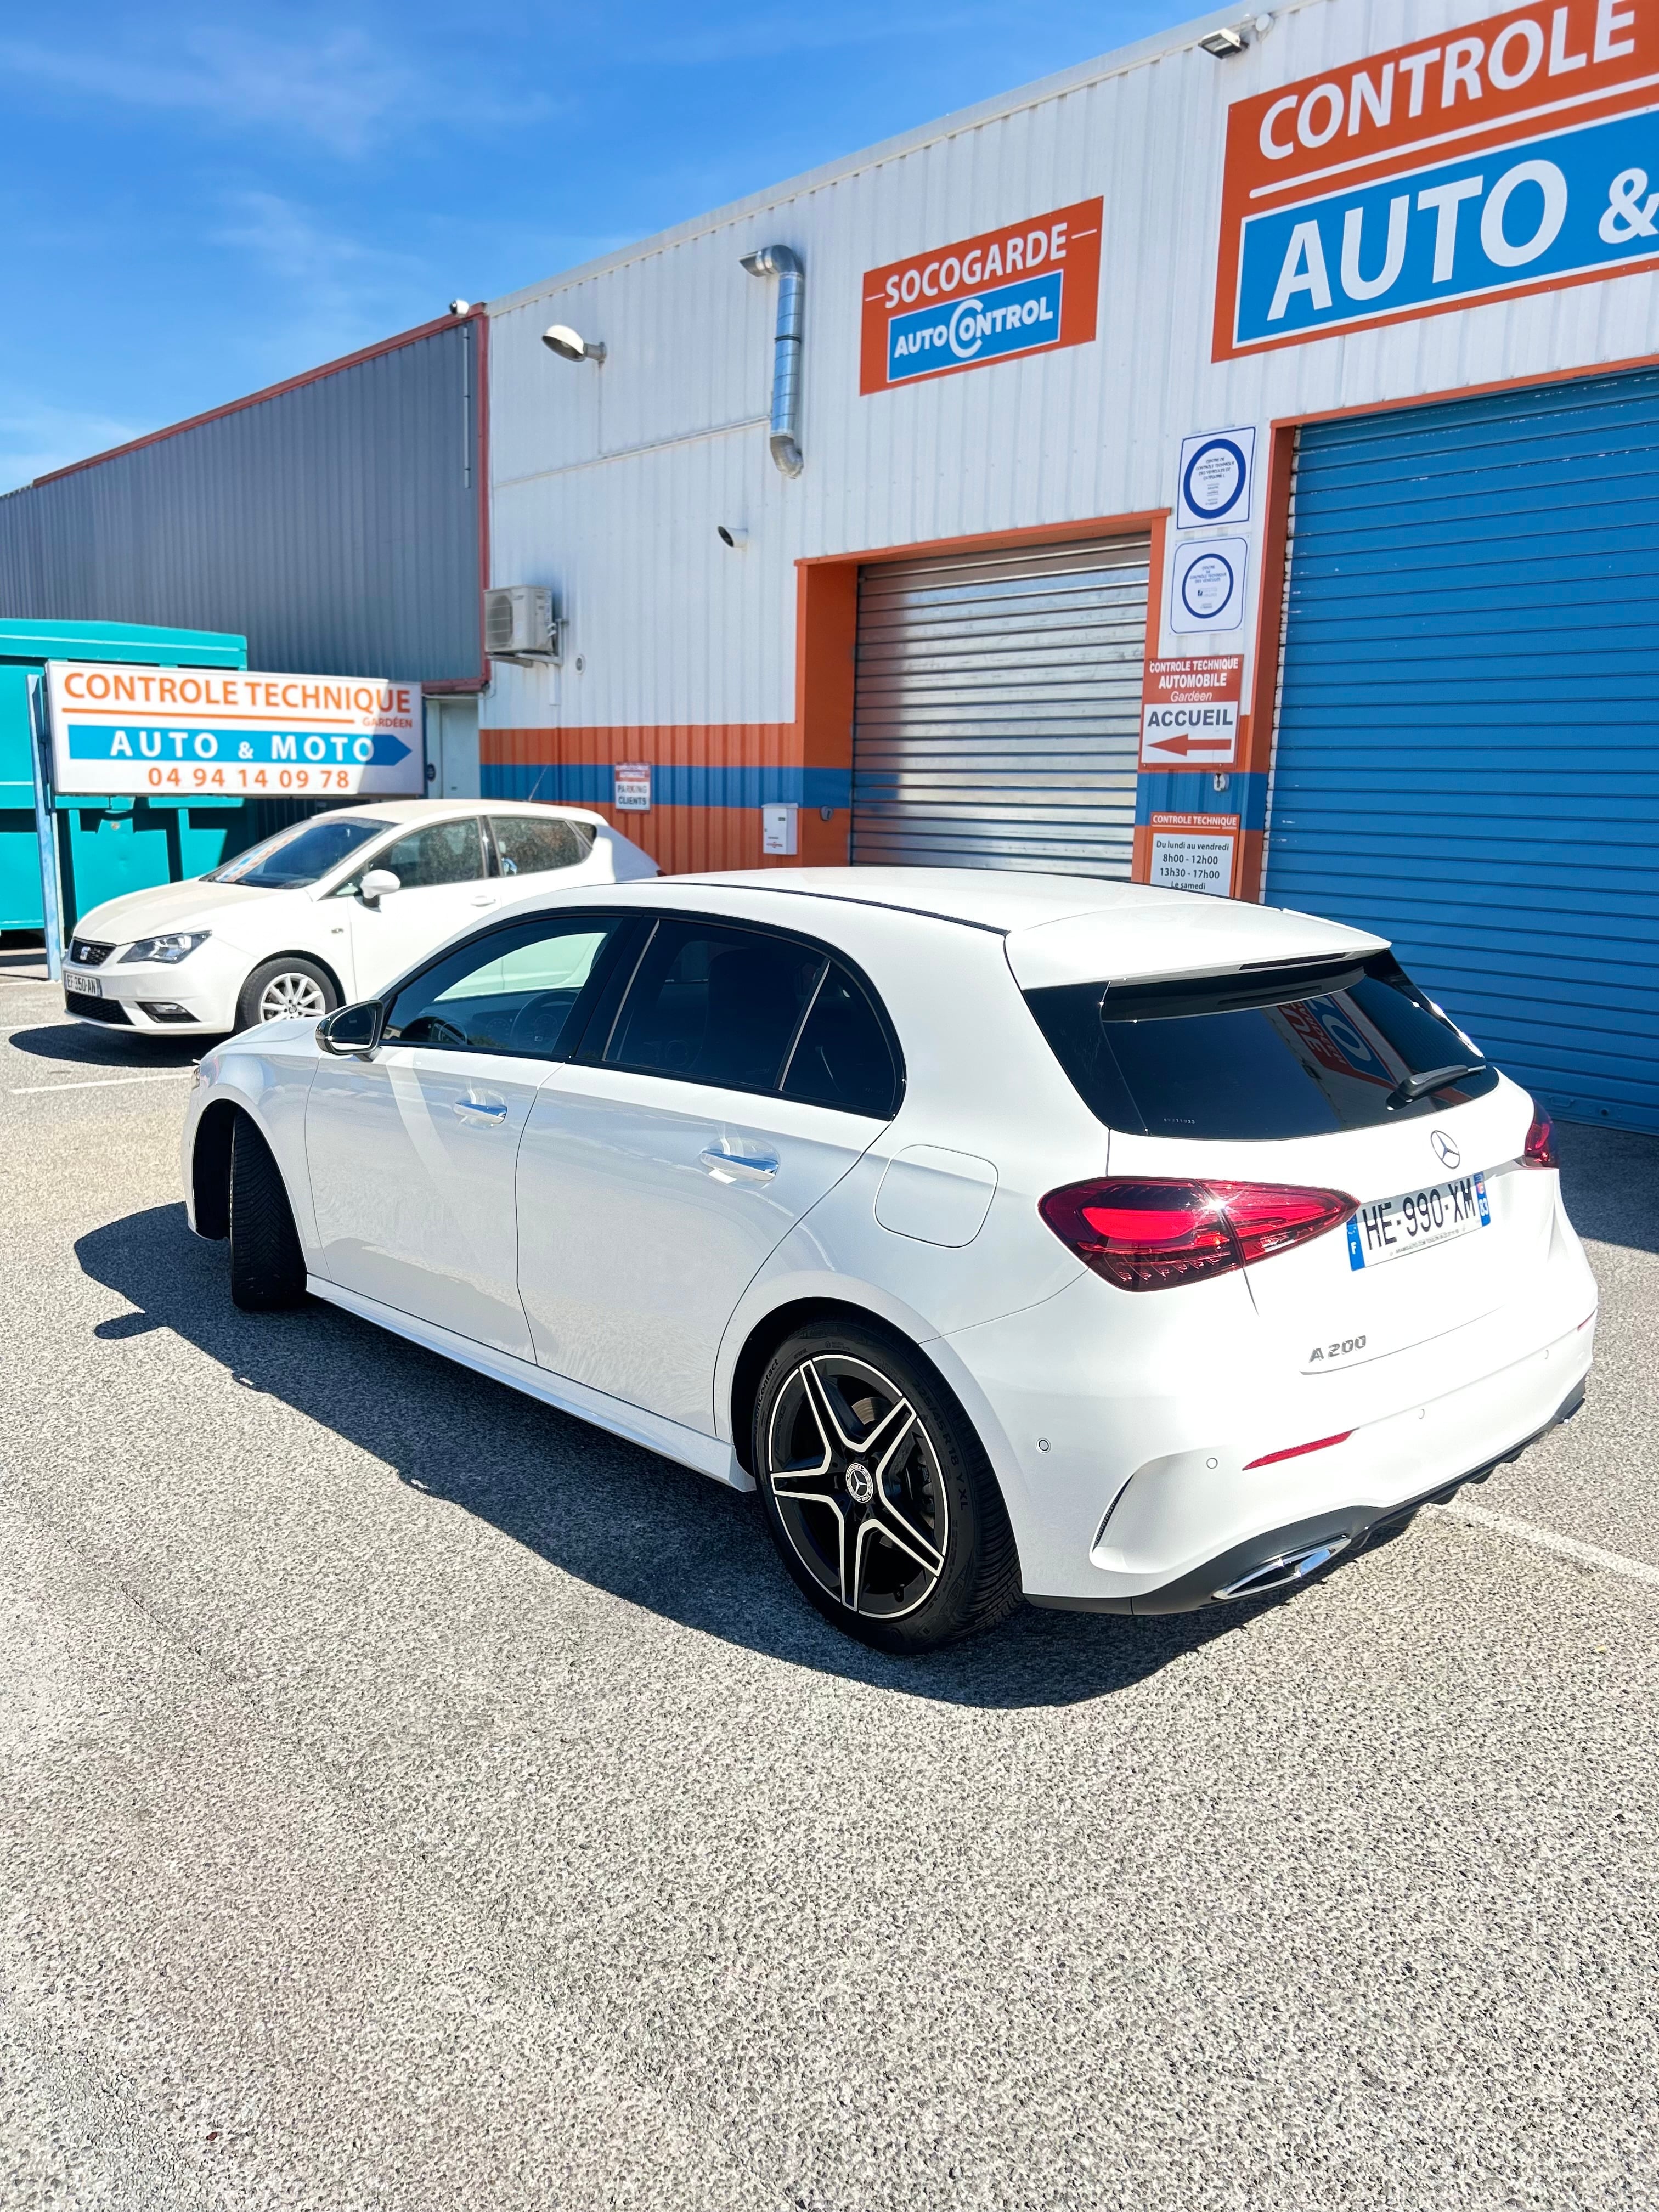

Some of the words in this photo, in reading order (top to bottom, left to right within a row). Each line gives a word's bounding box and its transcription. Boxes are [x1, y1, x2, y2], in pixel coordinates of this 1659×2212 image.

[1259, 0, 1635, 160] CONTROLE
[1267, 159, 1568, 321] AUTO
[1598, 167, 1659, 244] &
[884, 222, 1068, 309] SOCOGARDE
[1149, 660, 1191, 673] CONTROLE
[1193, 658, 1239, 671] TECHNIQUE
[1158, 673, 1227, 689] AUTOMOBILE
[64, 673, 238, 706] CONTROLE
[245, 682, 411, 715] TECHNIQUE
[362, 715, 413, 729] GARDÉEN
[1147, 709, 1233, 727] ACCUEIL
[110, 730, 218, 758] AUTO
[237, 741, 254, 759] &
[272, 735, 375, 761] MOTO
[148, 767, 182, 787] 04
[193, 768, 225, 787] 94
[238, 768, 268, 788] 14
[279, 769, 309, 788] 09
[320, 770, 350, 788] 78
[618, 796, 647, 805] CLIENTS
[1153, 815, 1192, 825] CONTROLE
[1193, 816, 1237, 827] TECHNIQUE
[1167, 840, 1186, 849] lundi
[1197, 842, 1229, 851] vendredi
[1163, 854, 1184, 863] 8h00
[1192, 855, 1218, 865] 12h00
[1160, 867, 1186, 877] 13h30
[1193, 869, 1220, 879] 17h00
[1171, 881, 1179, 889] Le
[1362, 1178, 1476, 1251] HE-990-XM
[1350, 1242, 1358, 1255] F
[1308, 1347, 1324, 1363] A
[1328, 1335, 1367, 1359] 200
[948, 1447, 960, 1466] 18
[958, 1488, 968, 1510] XL
